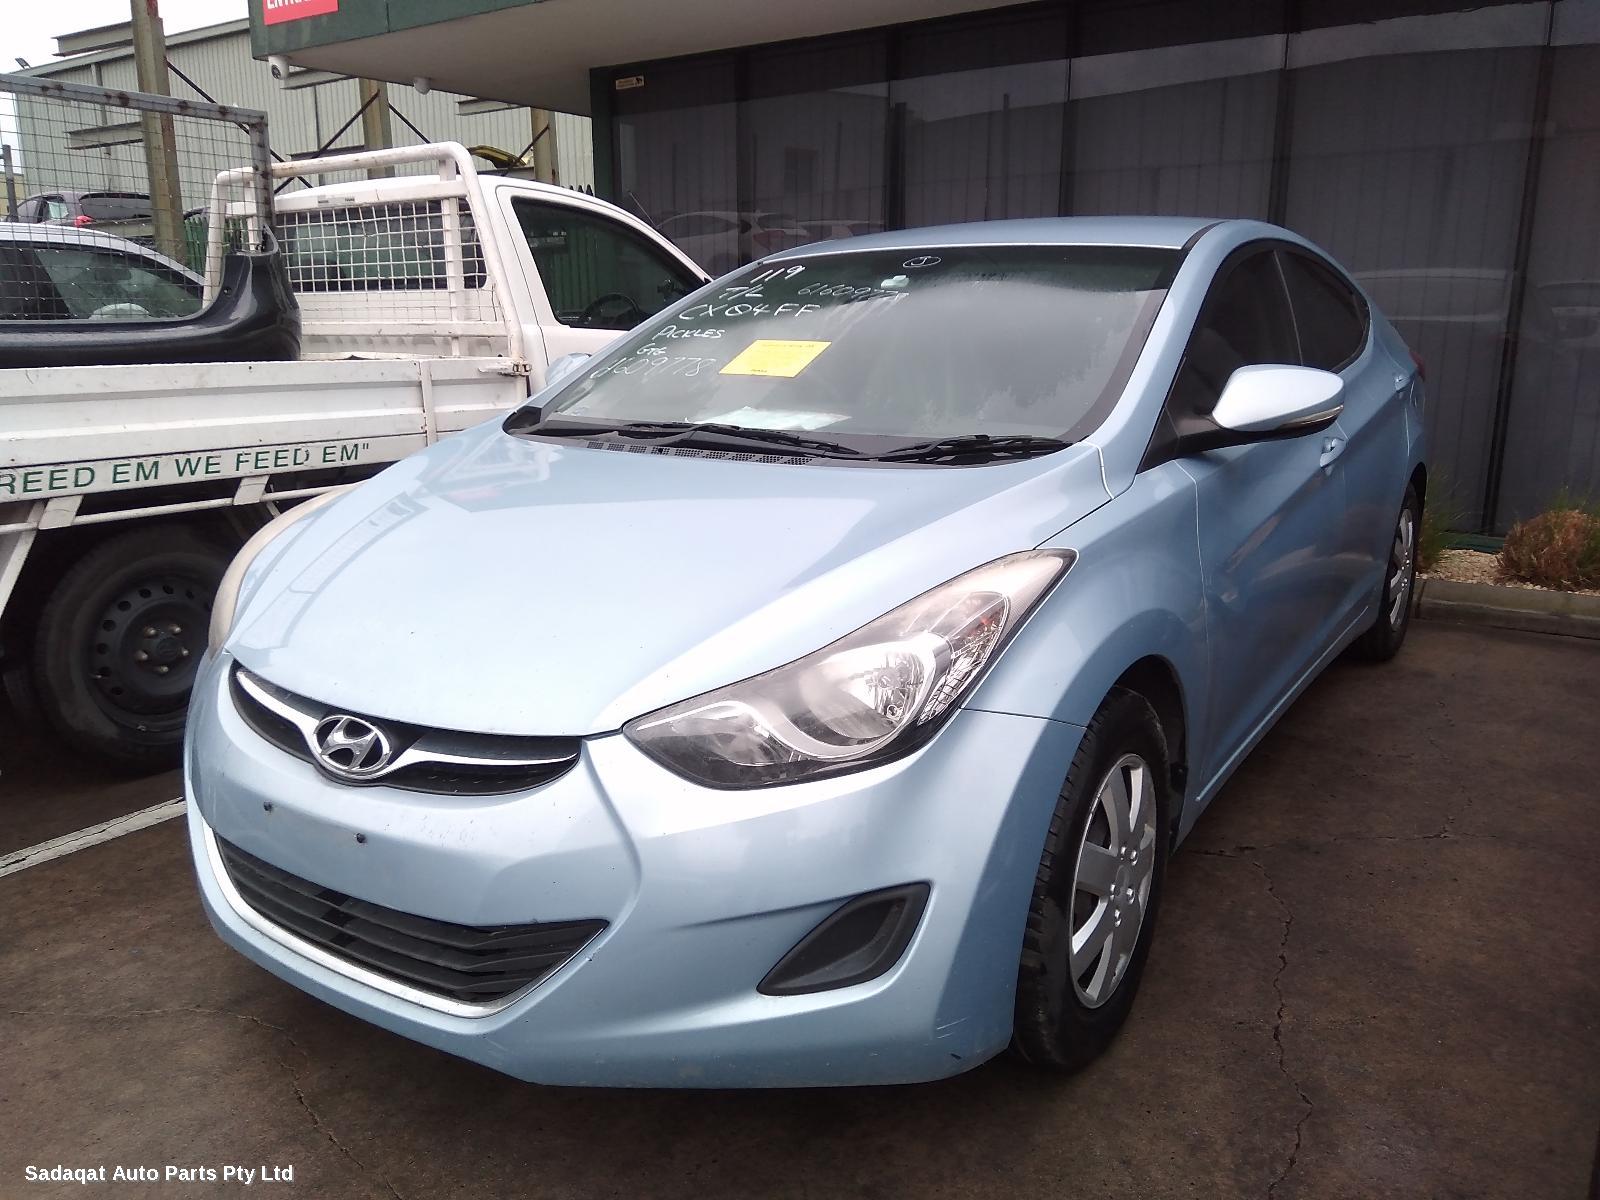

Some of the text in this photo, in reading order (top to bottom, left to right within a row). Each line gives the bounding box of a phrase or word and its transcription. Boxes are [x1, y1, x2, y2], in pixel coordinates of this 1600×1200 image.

[112, 460, 160, 484] EM
[174, 455, 222, 478] WE
[235, 447, 310, 472] FEED
